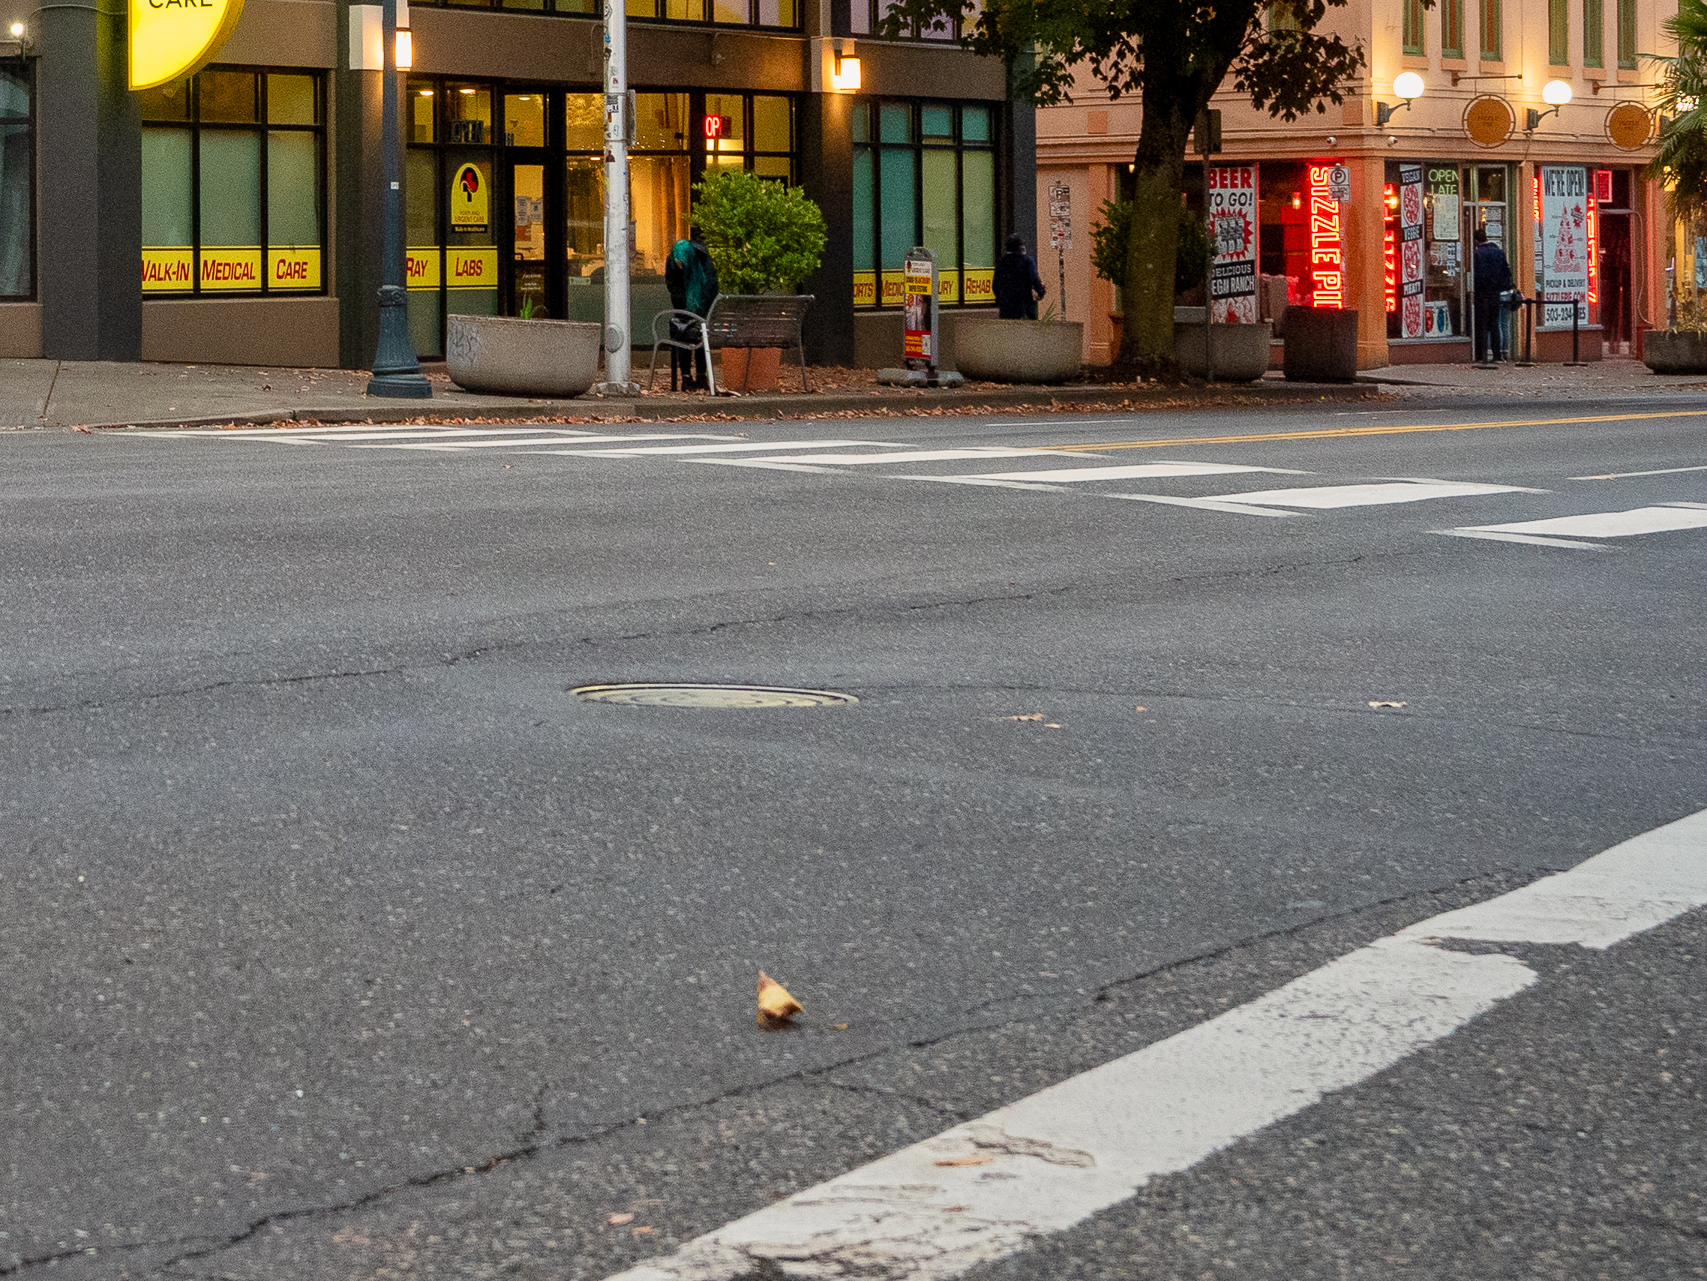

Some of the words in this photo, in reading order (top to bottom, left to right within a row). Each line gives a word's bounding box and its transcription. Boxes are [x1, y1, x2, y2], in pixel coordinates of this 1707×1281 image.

[1428, 169, 1459, 182] OPEN
[1543, 170, 1565, 197] WE'RE
[1228, 192, 1253, 207] GO!
[1430, 184, 1457, 195] LATE
[1310, 167, 1340, 264] SIZZLE
[142, 260, 190, 282] WALK-IN
[201, 260, 256, 281] MEDICAL
[276, 259, 308, 280] CARE
[455, 257, 483, 277] LABS
[966, 278, 991, 294] REHAB
[1211, 277, 1229, 296] EGAN
[1230, 275, 1254, 292] RANCH
